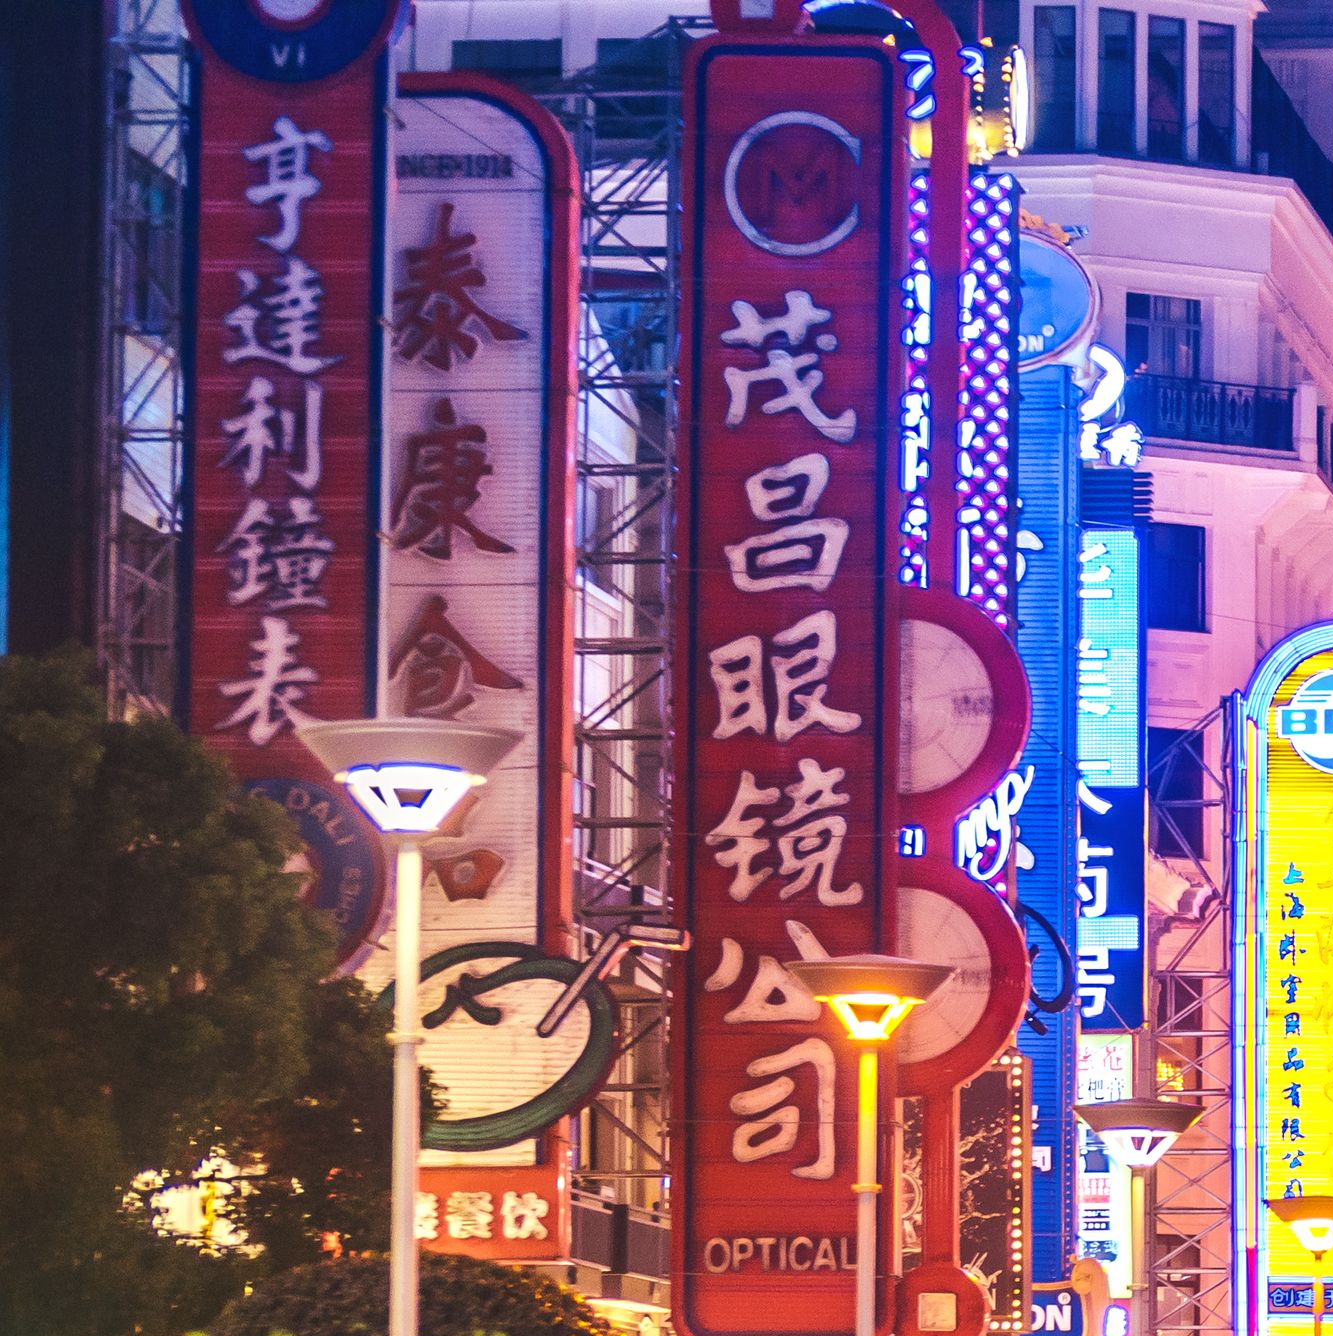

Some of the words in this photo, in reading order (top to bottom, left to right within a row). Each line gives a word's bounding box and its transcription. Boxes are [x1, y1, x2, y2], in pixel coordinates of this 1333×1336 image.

[704, 290, 865, 1181] 茂昌眼镜公司
[704, 1236, 858, 1274] OPTICAL
